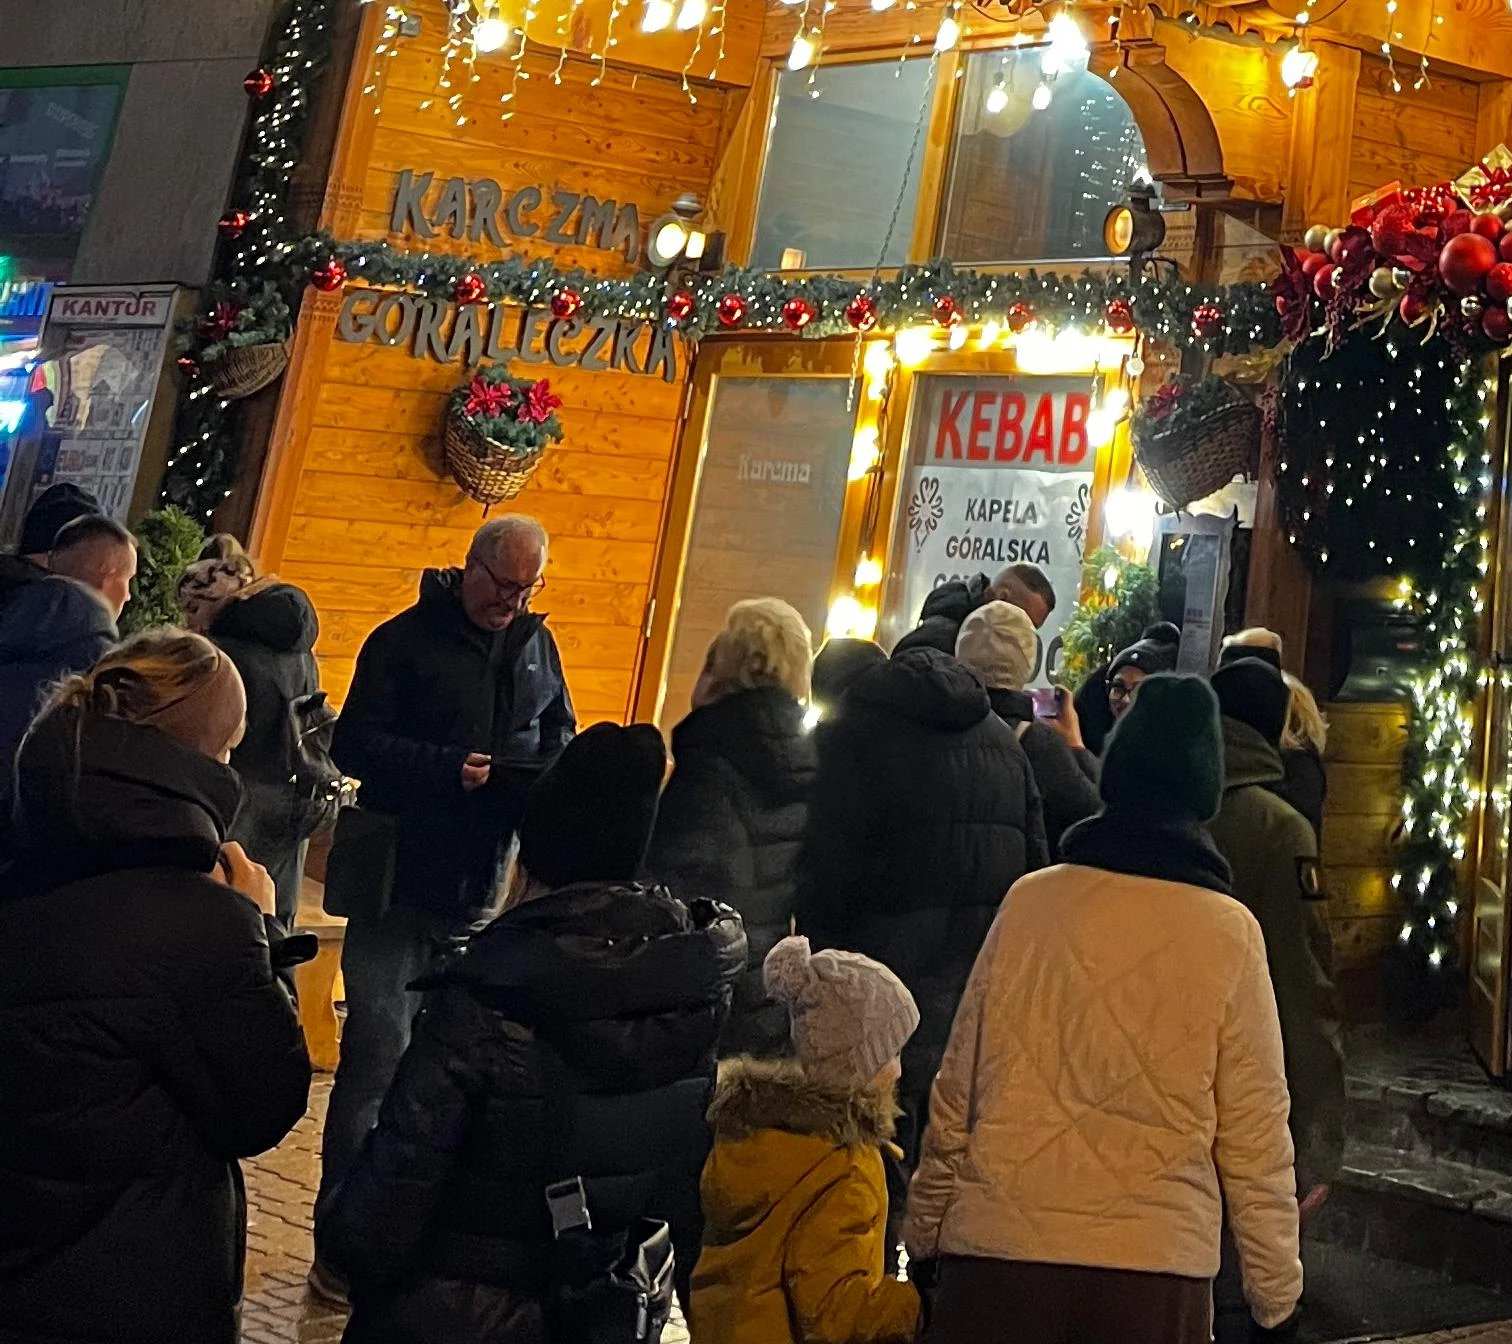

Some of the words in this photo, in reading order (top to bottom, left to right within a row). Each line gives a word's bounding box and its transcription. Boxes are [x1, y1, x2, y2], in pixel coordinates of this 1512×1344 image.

[390, 168, 640, 264] KARCZMA
[61, 298, 157, 317] KANTOR
[934, 389, 1091, 465] KEBAB
[964, 497, 1038, 525] KAPELA
[945, 529, 1051, 565] GÓRALSKA
